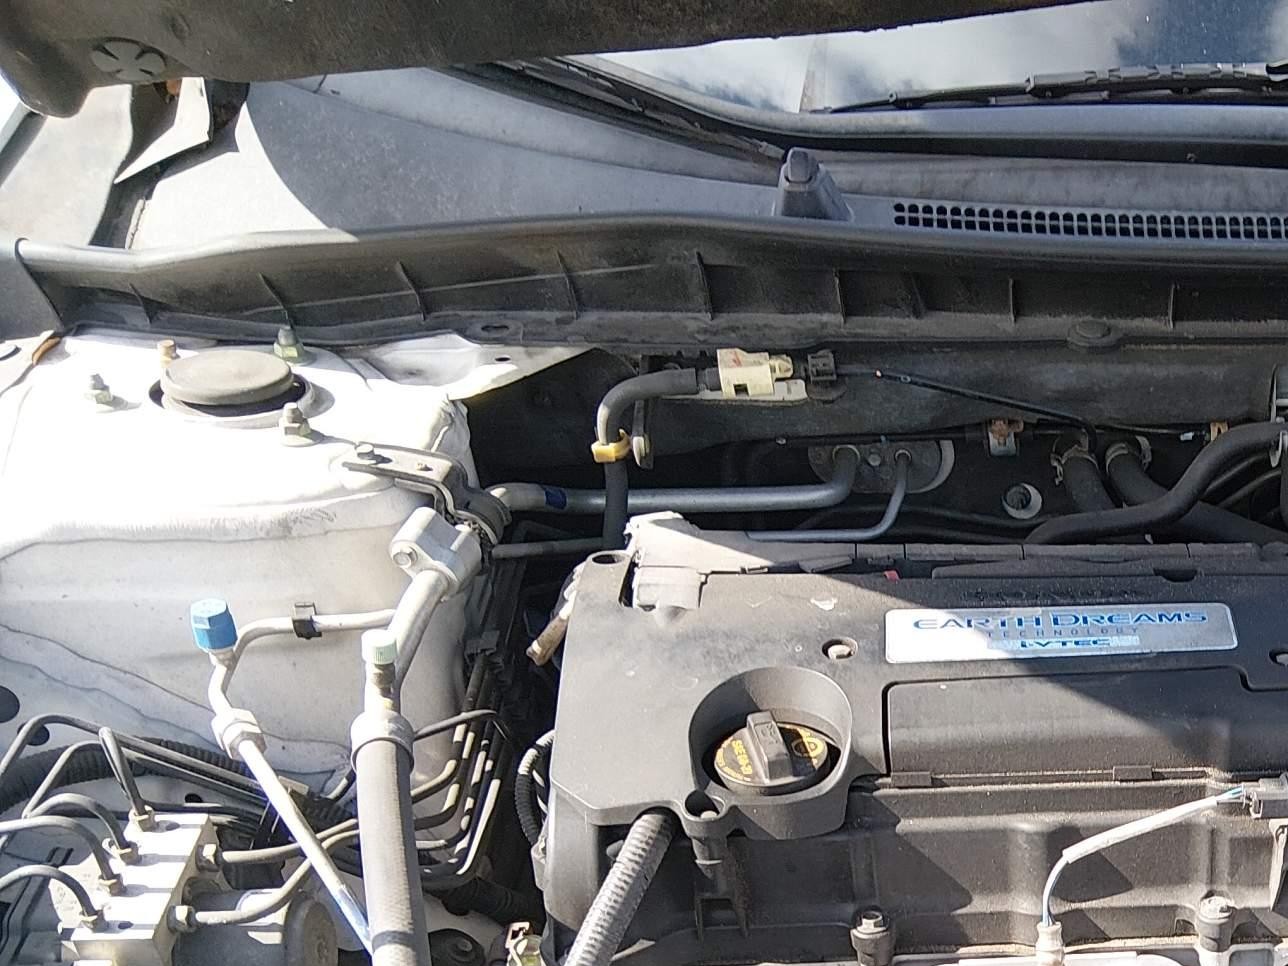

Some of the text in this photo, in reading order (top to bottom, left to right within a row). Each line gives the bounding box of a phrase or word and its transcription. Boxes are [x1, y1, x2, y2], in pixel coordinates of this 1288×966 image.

[912, 610, 1209, 631] EARTH DREAMS
[988, 626, 1140, 639] TECHNOLOGY
